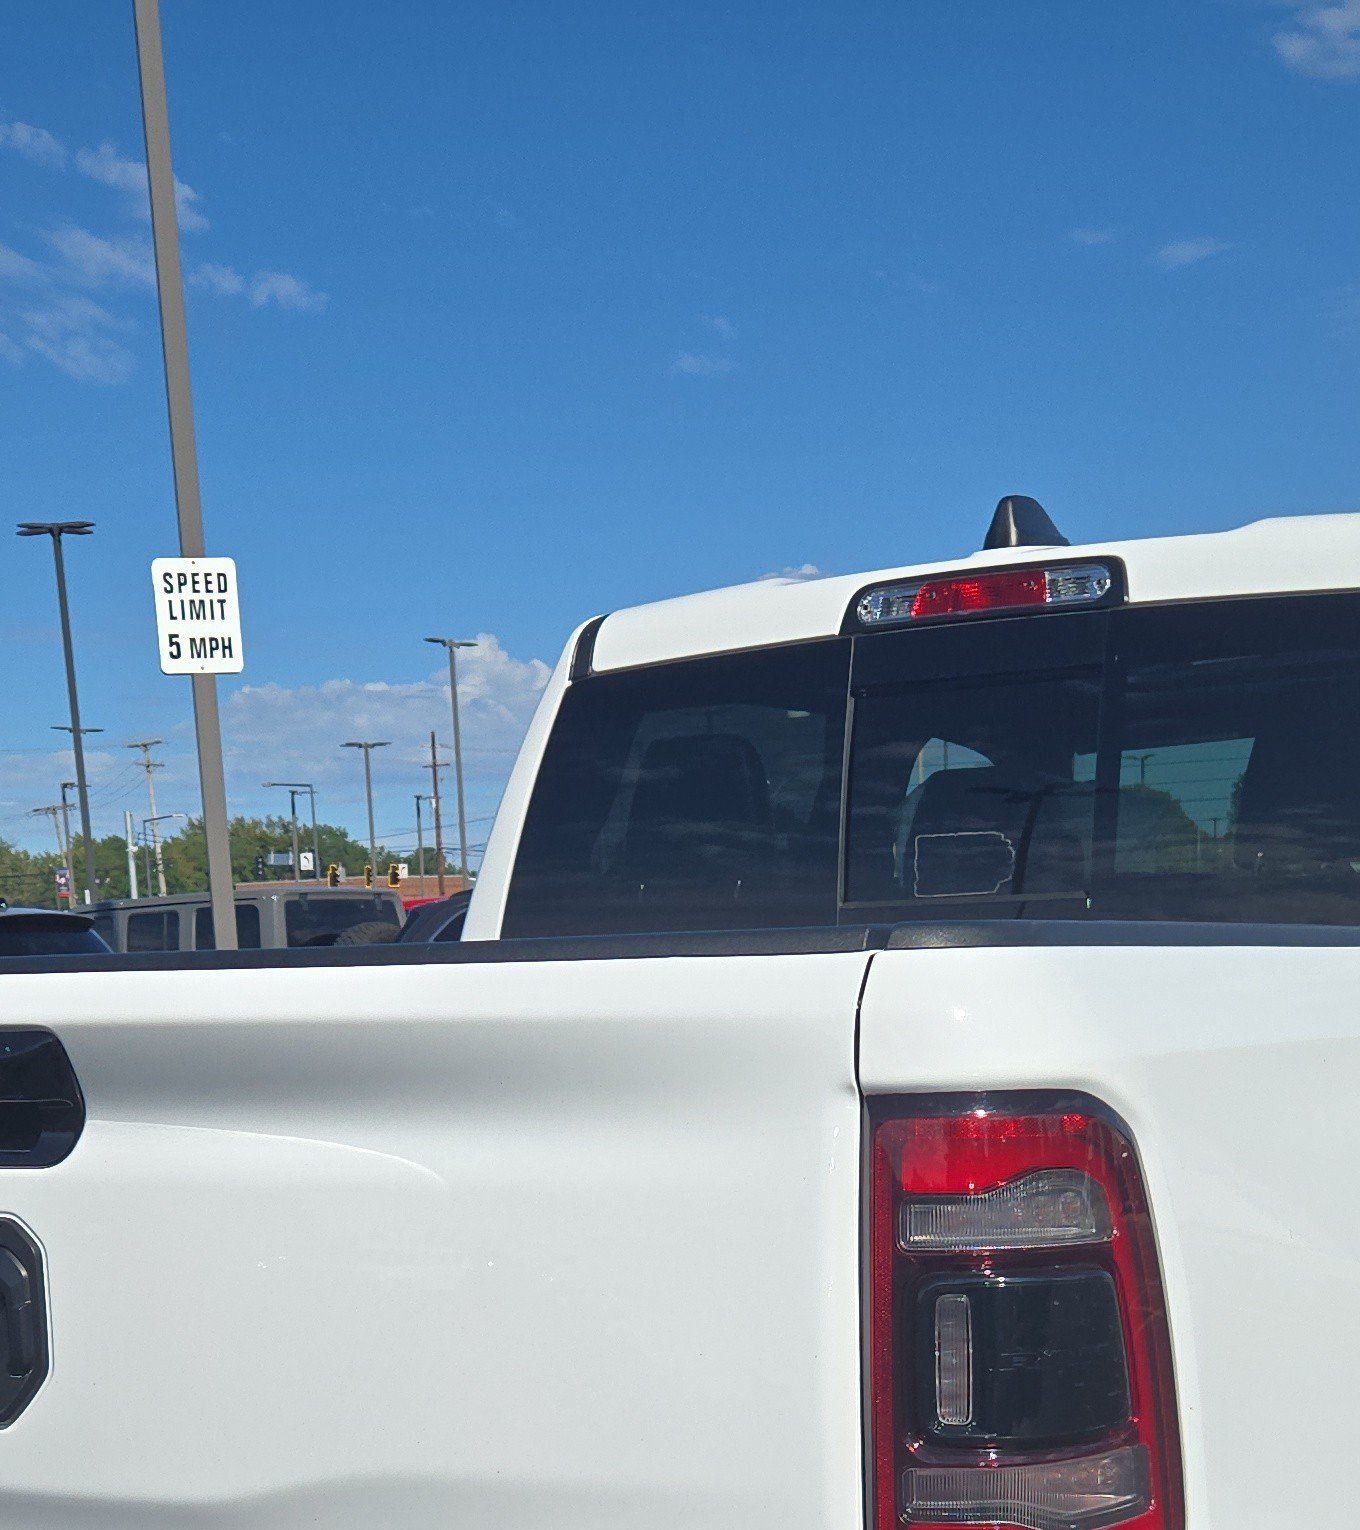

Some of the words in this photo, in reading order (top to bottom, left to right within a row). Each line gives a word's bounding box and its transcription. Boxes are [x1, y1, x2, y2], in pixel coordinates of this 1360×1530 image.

[162, 571, 228, 594] SPEED
[167, 598, 227, 621] LIMIT
[167, 633, 182, 660] 5
[189, 636, 234, 660] MPH
